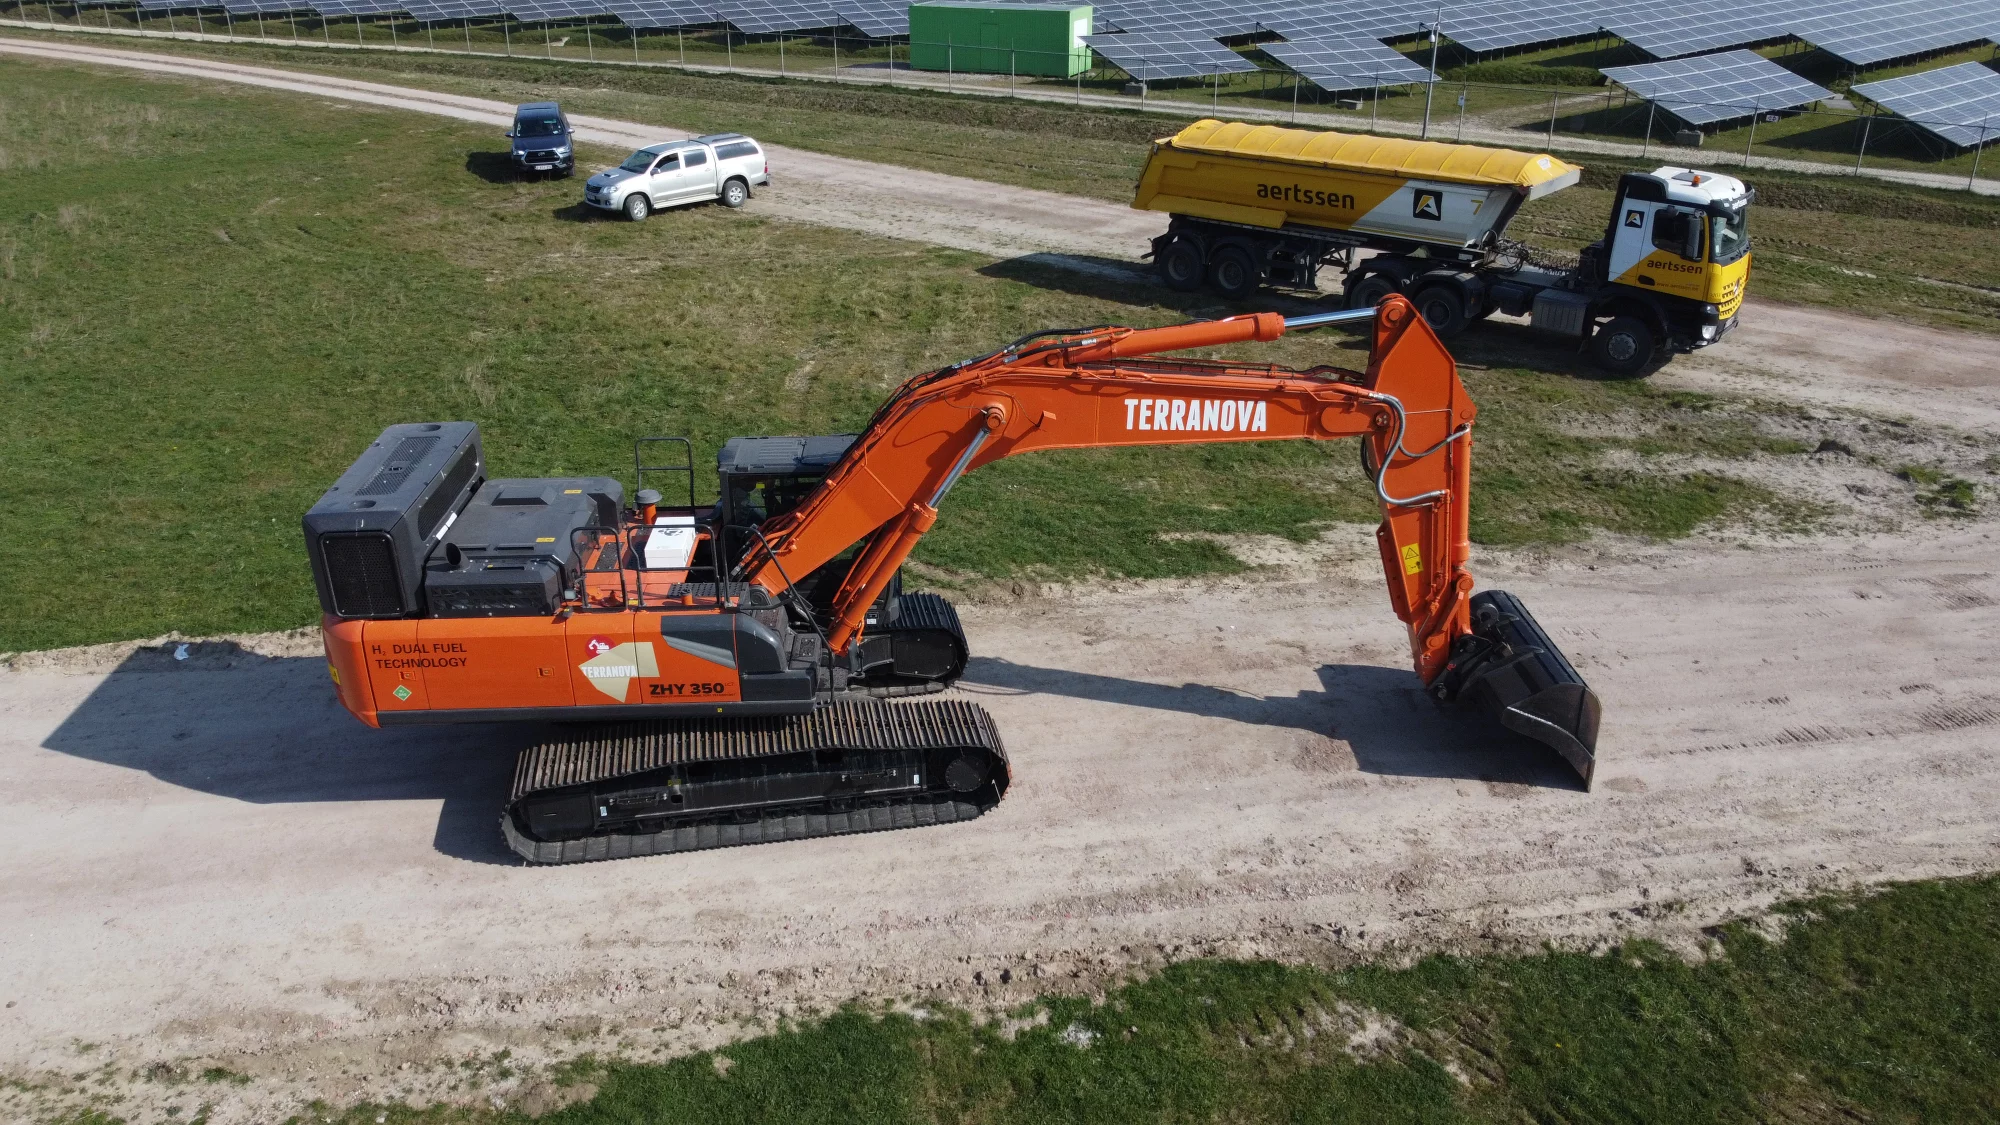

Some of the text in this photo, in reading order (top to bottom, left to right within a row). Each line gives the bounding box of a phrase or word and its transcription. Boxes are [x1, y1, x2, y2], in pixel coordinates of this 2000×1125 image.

[1257, 183, 1355, 210] aertssen
[1647, 260, 1703, 274] aertssen
[1124, 399, 1267, 432] TERRANOVA
[393, 644, 430, 654] DUAL
[433, 643, 467, 653] FUEL
[375, 657, 467, 669] TECHNOLOGY
[581, 665, 637, 678] TERRANOVA
[649, 684, 685, 695] ZHY
[690, 682, 725, 694] 350
